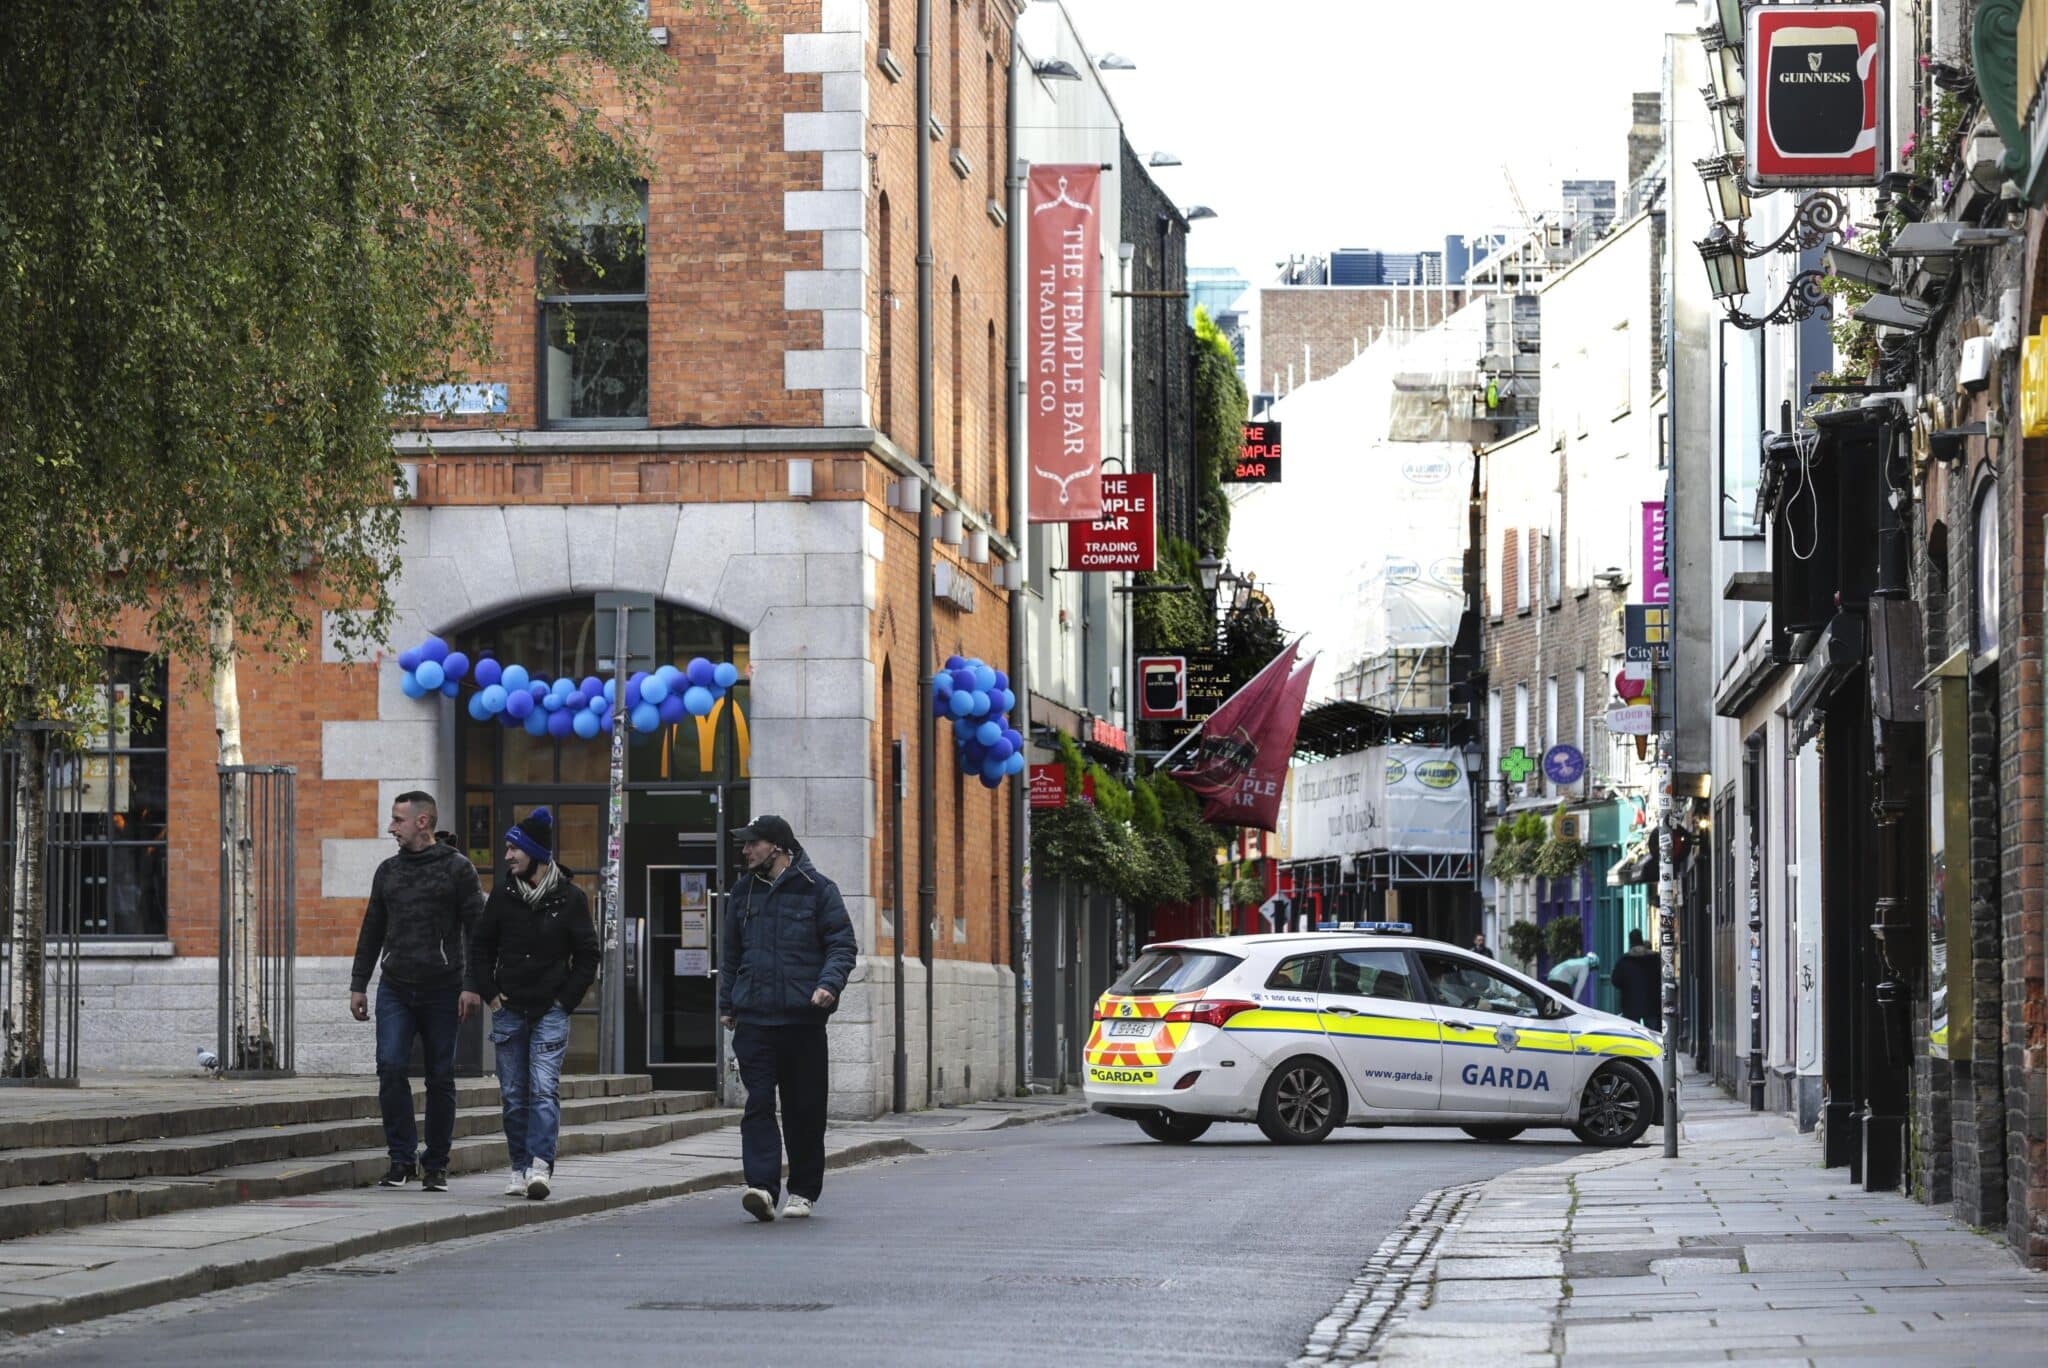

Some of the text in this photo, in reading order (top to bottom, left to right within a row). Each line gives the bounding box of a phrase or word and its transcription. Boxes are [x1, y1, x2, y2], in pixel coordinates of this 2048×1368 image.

[1780, 72, 1850, 83] GUINNESS
[1040, 264, 1057, 417] TRADING CO.
[1063, 224, 1085, 457] THE TEMPLE BAR
[1243, 426, 1265, 441] HE
[1240, 444, 1281, 459] MPLE
[1235, 463, 1266, 478] BAR
[1102, 480, 1128, 494] HE
[1102, 498, 1146, 513] MPLE
[1085, 541, 1138, 553] TRADING
[1081, 553, 1140, 565] COMPANY
[1242, 779, 1278, 797] PLE
[1097, 1071, 1144, 1083] GARDA
[1365, 1068, 1434, 1082] www.garda.ie
[1461, 1063, 1551, 1092] GARDA
